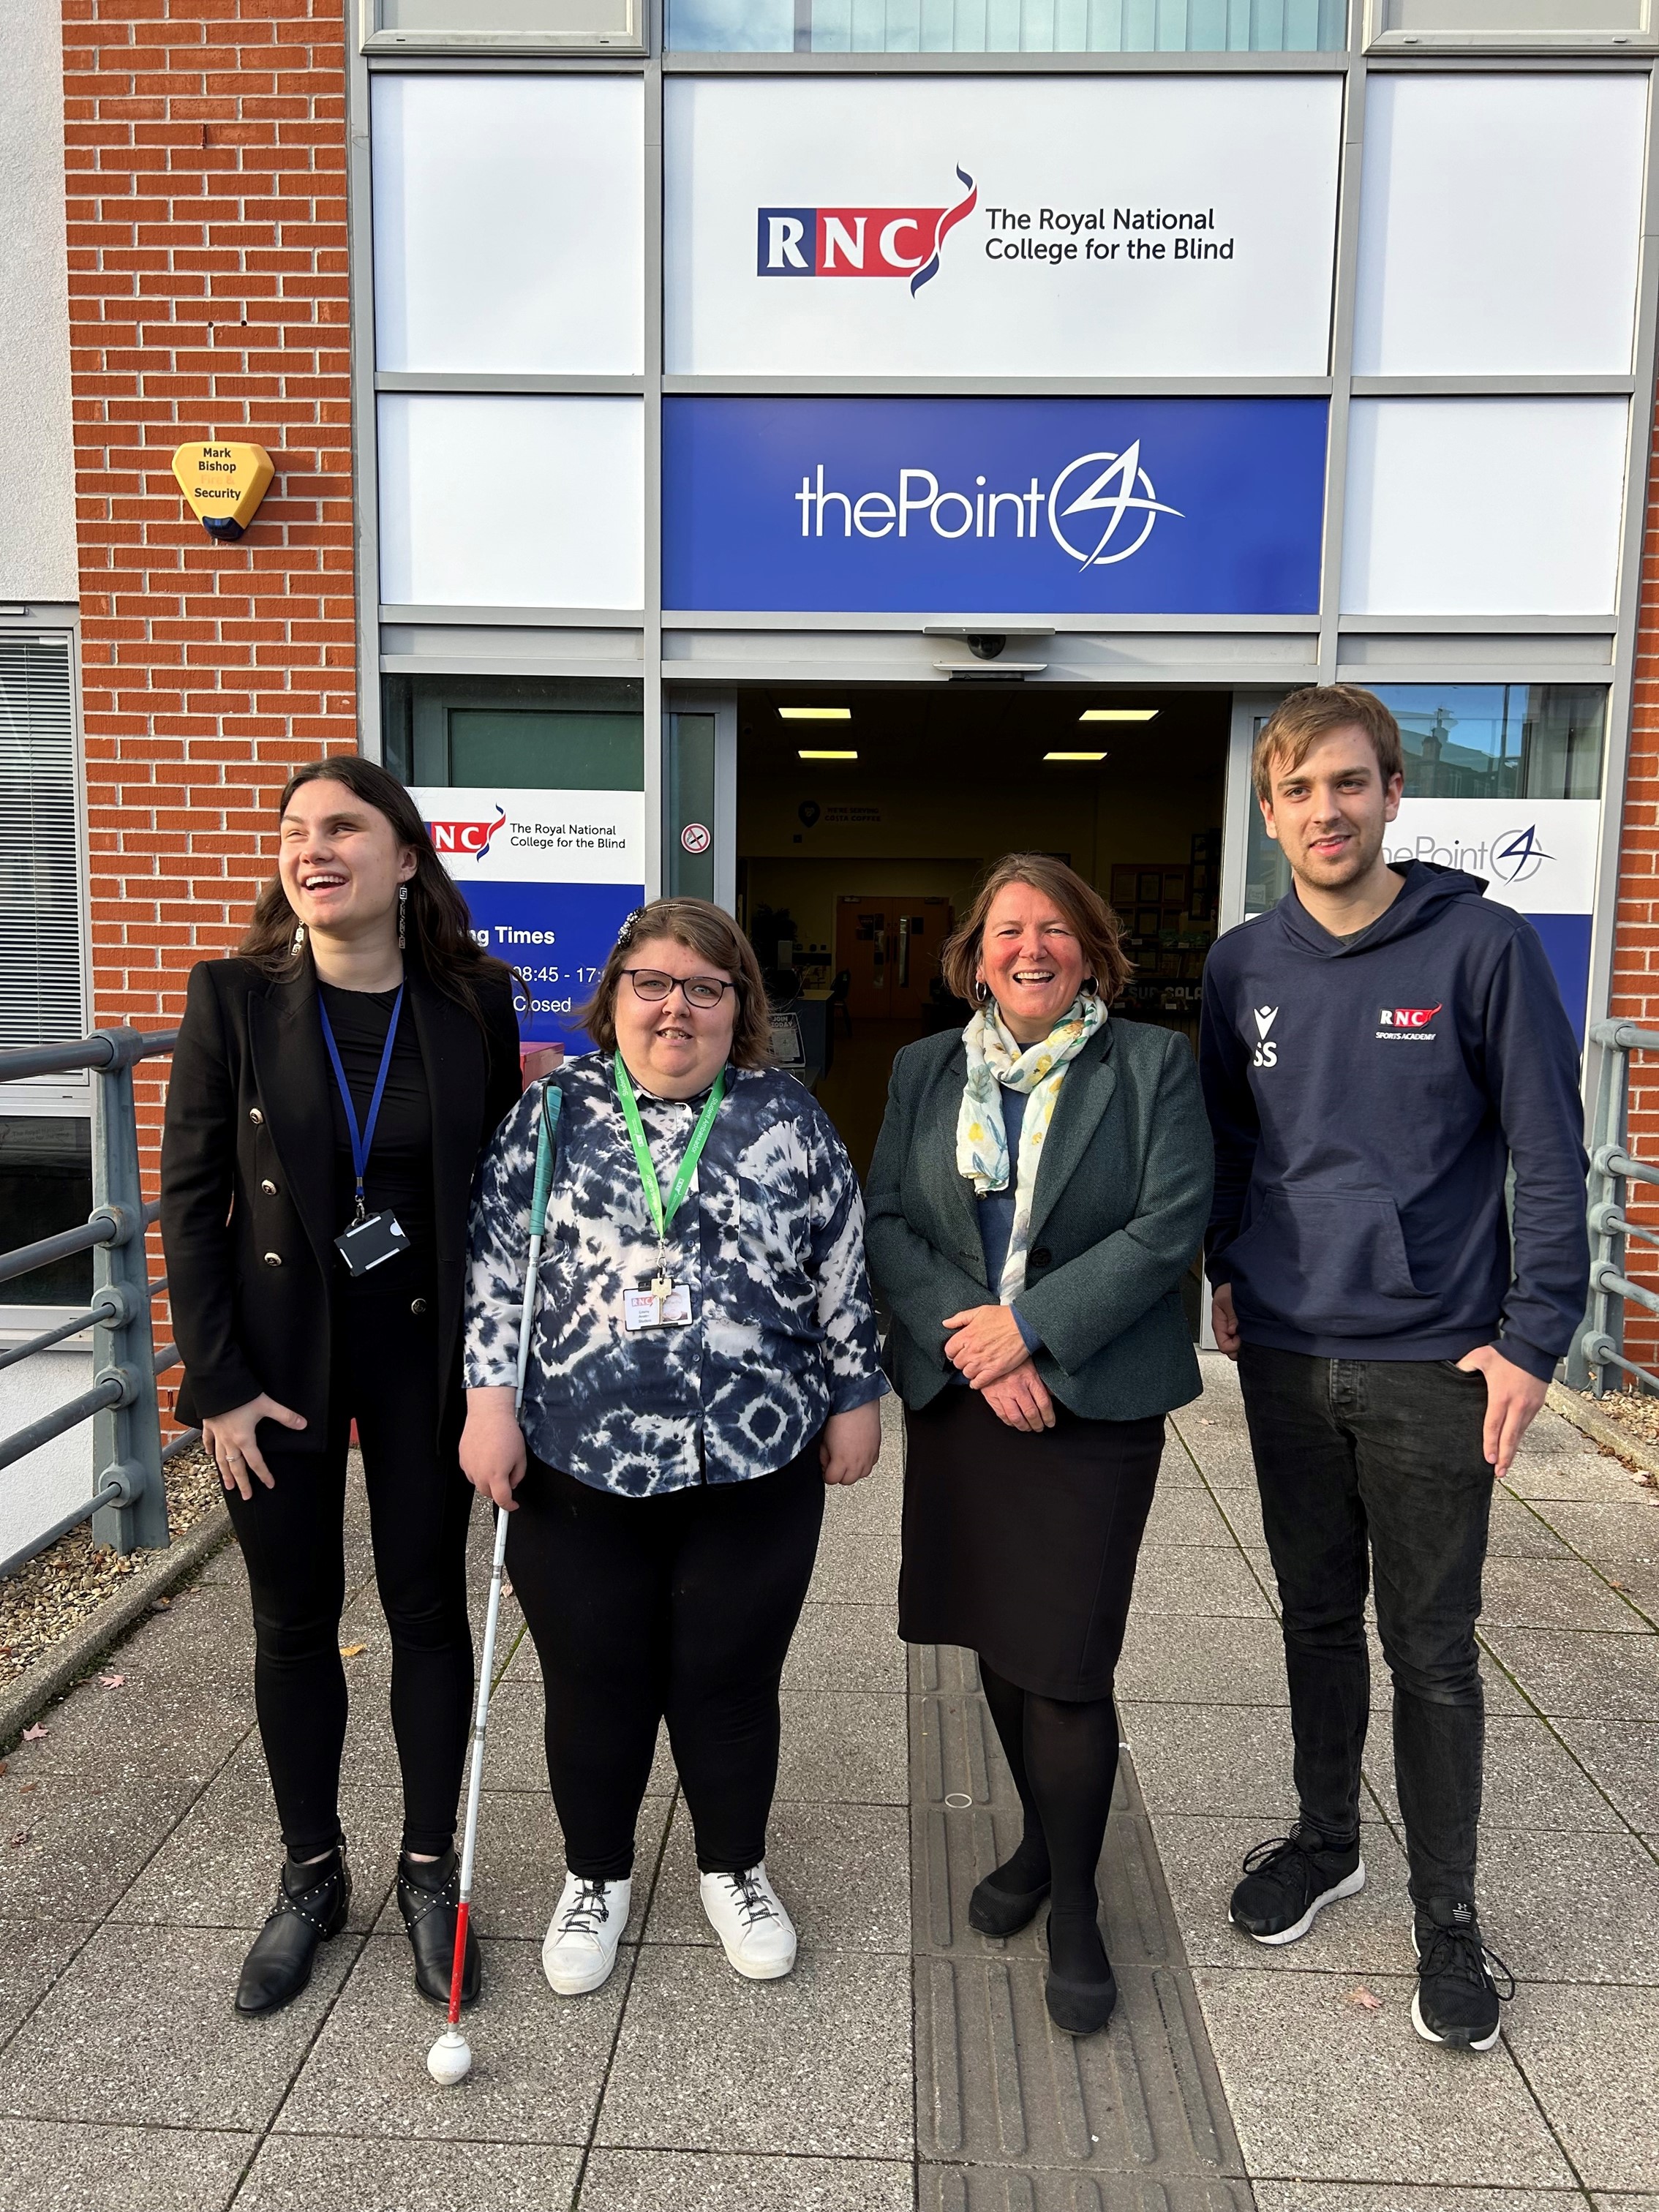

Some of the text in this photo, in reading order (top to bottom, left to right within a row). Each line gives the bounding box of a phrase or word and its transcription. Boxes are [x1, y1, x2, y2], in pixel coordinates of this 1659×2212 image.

[985, 208, 1215, 236] The Royal National
[767, 216, 923, 269] RNC
[985, 238, 1234, 265] College for the Blind
[203, 448, 231, 458] Mark
[198, 461, 236, 473] Bishop
[200, 475, 221, 485] Fire
[195, 488, 241, 500] Security
[794, 464, 1045, 538] thePoint
[434, 825, 482, 850] NC
[510, 823, 616, 837] The Royal National
[510, 836, 626, 849] College for the Blind
[494, 925, 555, 945] Times
[512, 966, 560, 983] 08:45
[513, 995, 571, 1013] Cosed
[1380, 1009, 1425, 1026] RNC
[1375, 1031, 1437, 1041] SPORTS ACADEMY
[618, 1075, 629, 1096] Student
[691, 1096, 719, 1154] Student Ambassador
[632, 1298, 650, 1306] RNC
